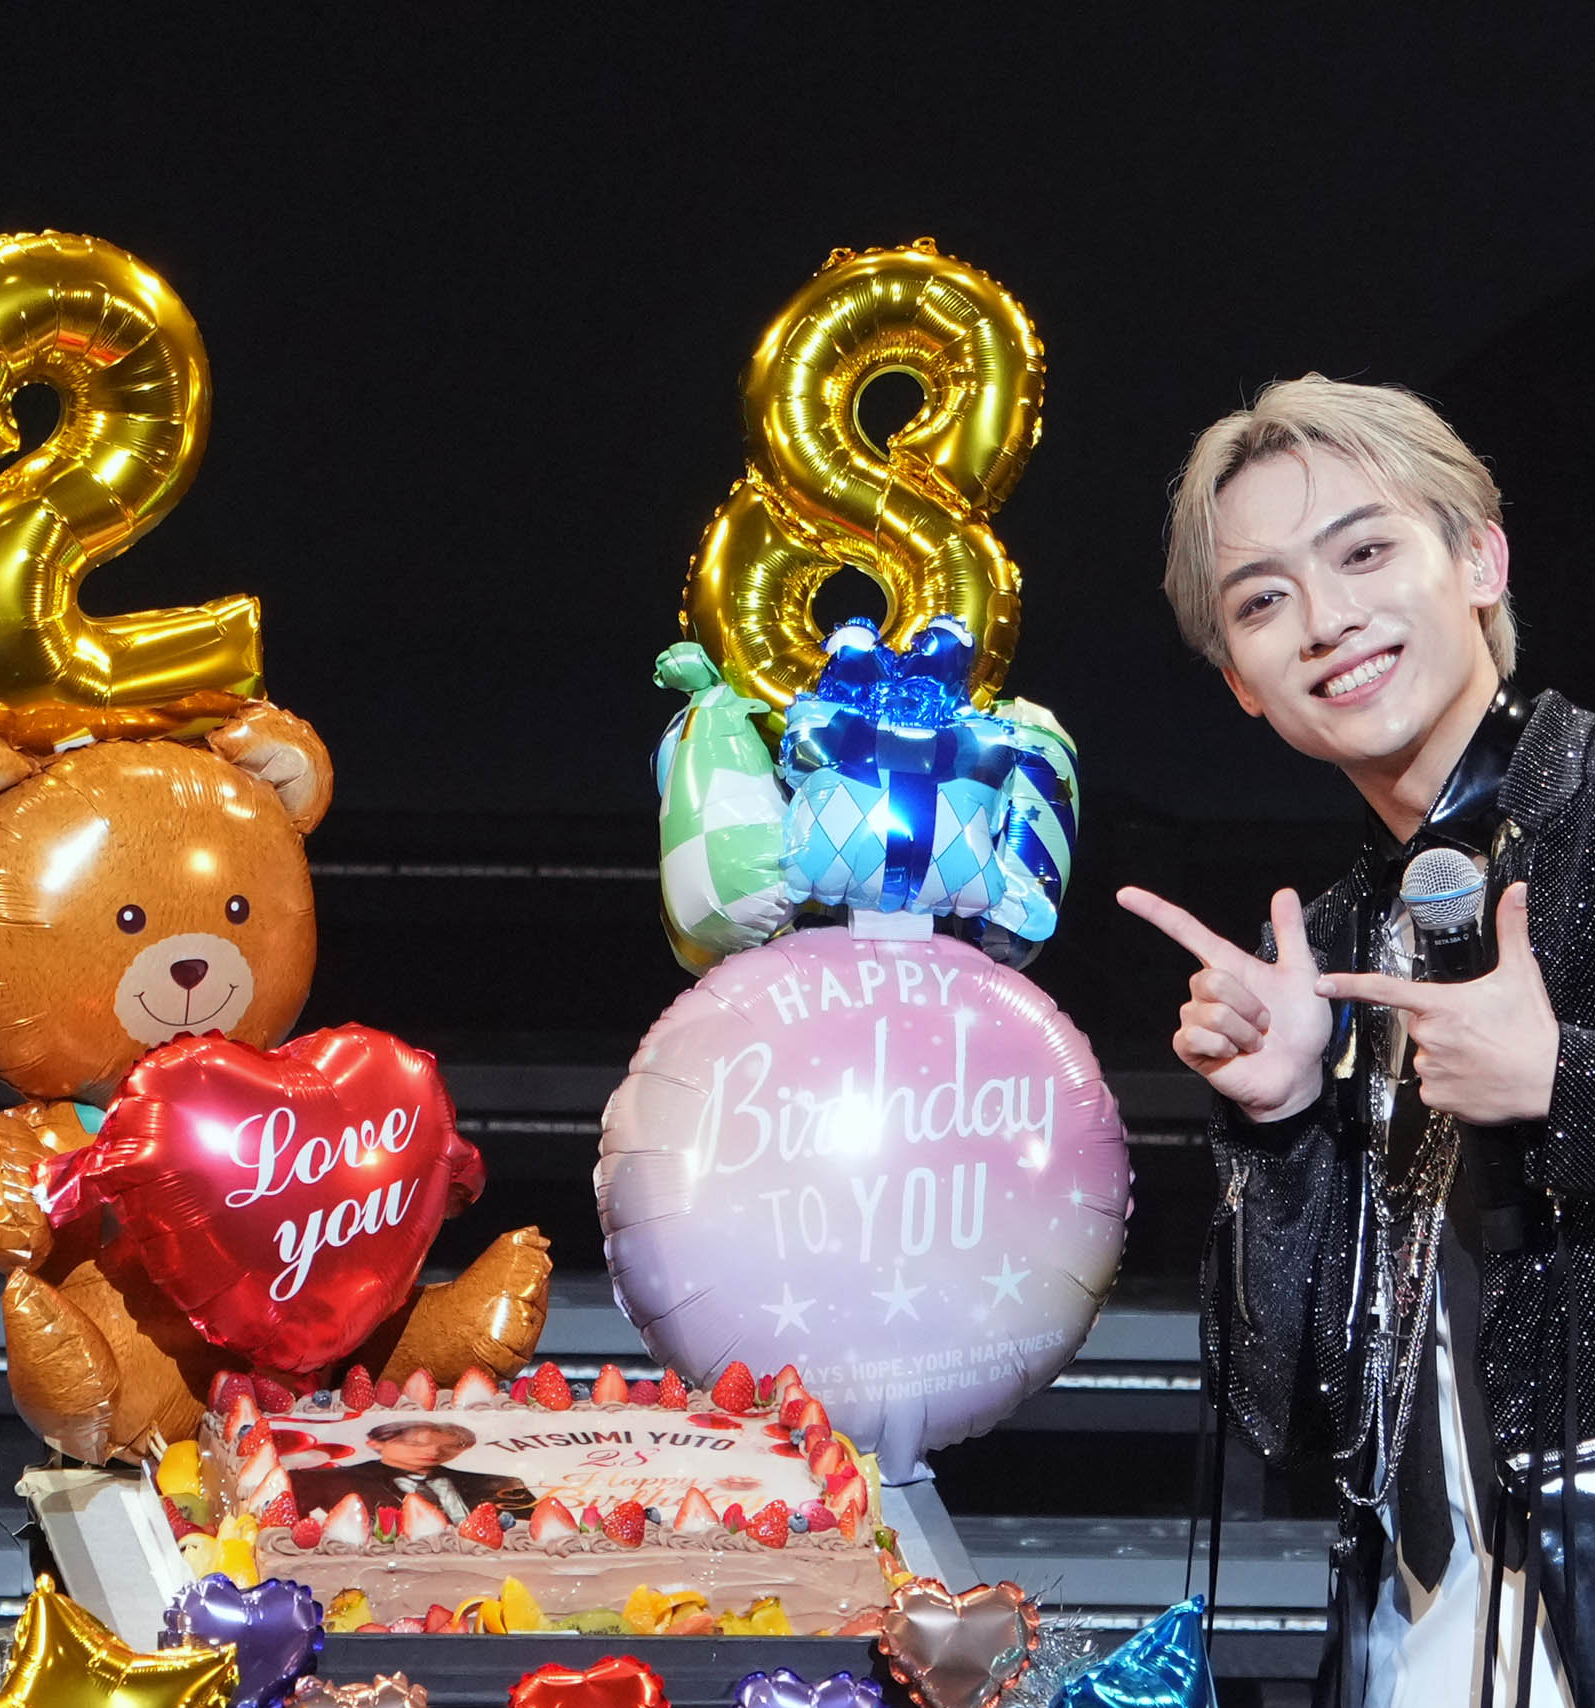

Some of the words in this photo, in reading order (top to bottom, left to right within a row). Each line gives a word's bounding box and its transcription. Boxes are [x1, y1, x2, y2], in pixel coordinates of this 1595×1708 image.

[679, 237, 1045, 745] 8
[767, 960, 959, 1025] HAPPY
[688, 1015, 1055, 1178] Birthday
[226, 1105, 420, 1207] Love
[270, 1178, 419, 1302] you
[758, 1185, 828, 1260] TO
[851, 1162, 987, 1263] YOU
[844, 1386, 858, 1404] A
[865, 1369, 982, 1402] WONDERFUL
[851, 1356, 909, 1381] HOPE
[913, 1349, 963, 1374] YOUR
[485, 1431, 632, 1454] TATSUMI
[647, 1431, 736, 1451] YUTO
[578, 1449, 660, 1468] 28
[563, 1470, 702, 1491] Happy
